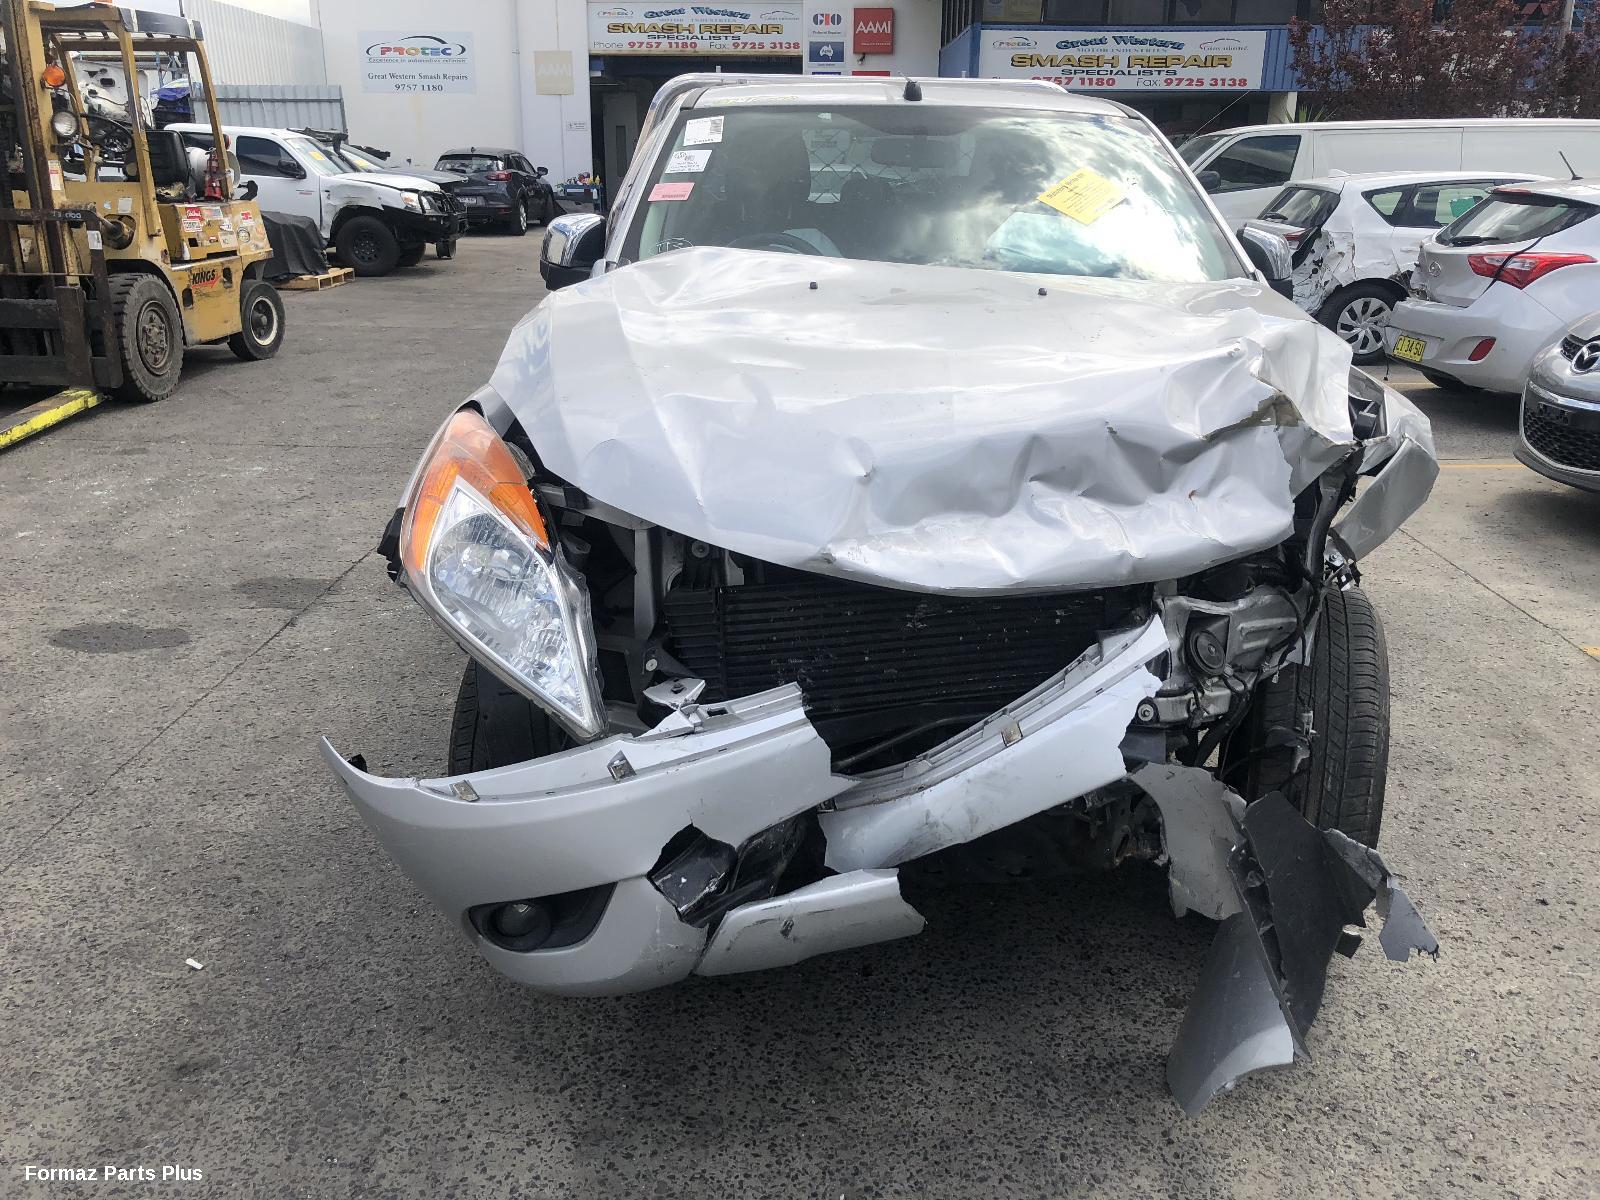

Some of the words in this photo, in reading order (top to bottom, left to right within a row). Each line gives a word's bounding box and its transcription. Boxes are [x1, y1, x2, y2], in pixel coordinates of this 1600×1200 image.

[644, 7, 686, 19] Great
[691, 6, 751, 20] Western
[607, 22, 695, 34] SMASH
[699, 23, 784, 35] REPAIR
[855, 20, 891, 34] AAMI
[593, 41, 624, 49] Phone
[627, 41, 662, 49] 9757
[667, 41, 698, 49] 1180
[732, 41, 765, 50] 9725
[769, 41, 800, 50] 3138
[1055, 36, 1108, 50] Great
[1112, 35, 1185, 50] Western
[380, 46, 452, 57] PROTEC
[1011, 53, 1120, 69] SMASH
[1127, 55, 1233, 69] REPAIR
[367, 72, 387, 80] Great
[388, 72, 416, 80] Western
[442, 73, 468, 81] Repairs
[1061, 68, 1178, 76] SPECIALISTS
[395, 83, 417, 92] 9757
[421, 84, 443, 92] 1180
[1079, 77, 1116, 87] 1180
[1136, 78, 1161, 87] Fax:
[1163, 77, 1205, 87] 9725
[1209, 78, 1248, 87] 3138
[192, 269, 216, 285] KINGS
